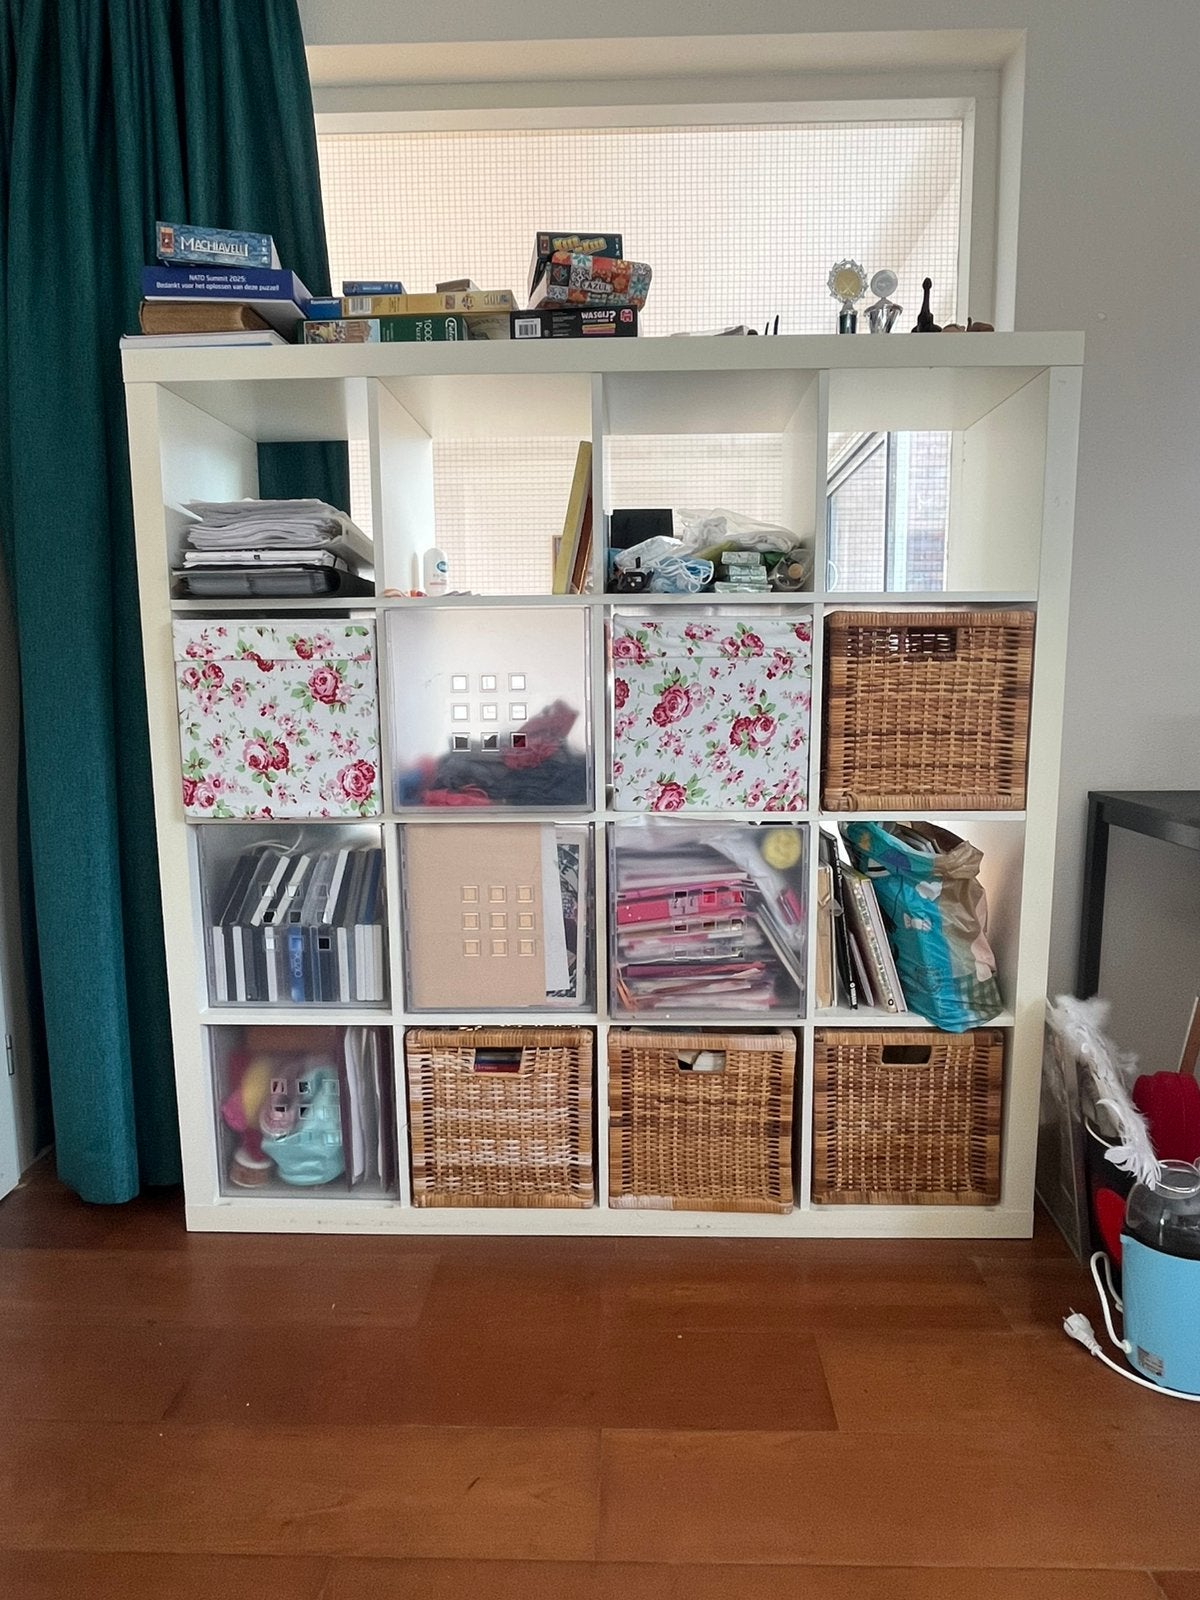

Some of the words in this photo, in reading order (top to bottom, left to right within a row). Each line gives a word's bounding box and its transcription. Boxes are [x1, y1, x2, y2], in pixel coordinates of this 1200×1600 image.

[180, 236, 249, 257] MACHIAVELLI
[188, 273, 205, 281] NATO
[206, 274, 228, 282] Summit
[156, 281, 180, 289] Bedankt
[244, 283, 258, 291] deze
[587, 281, 609, 292] AZUL
